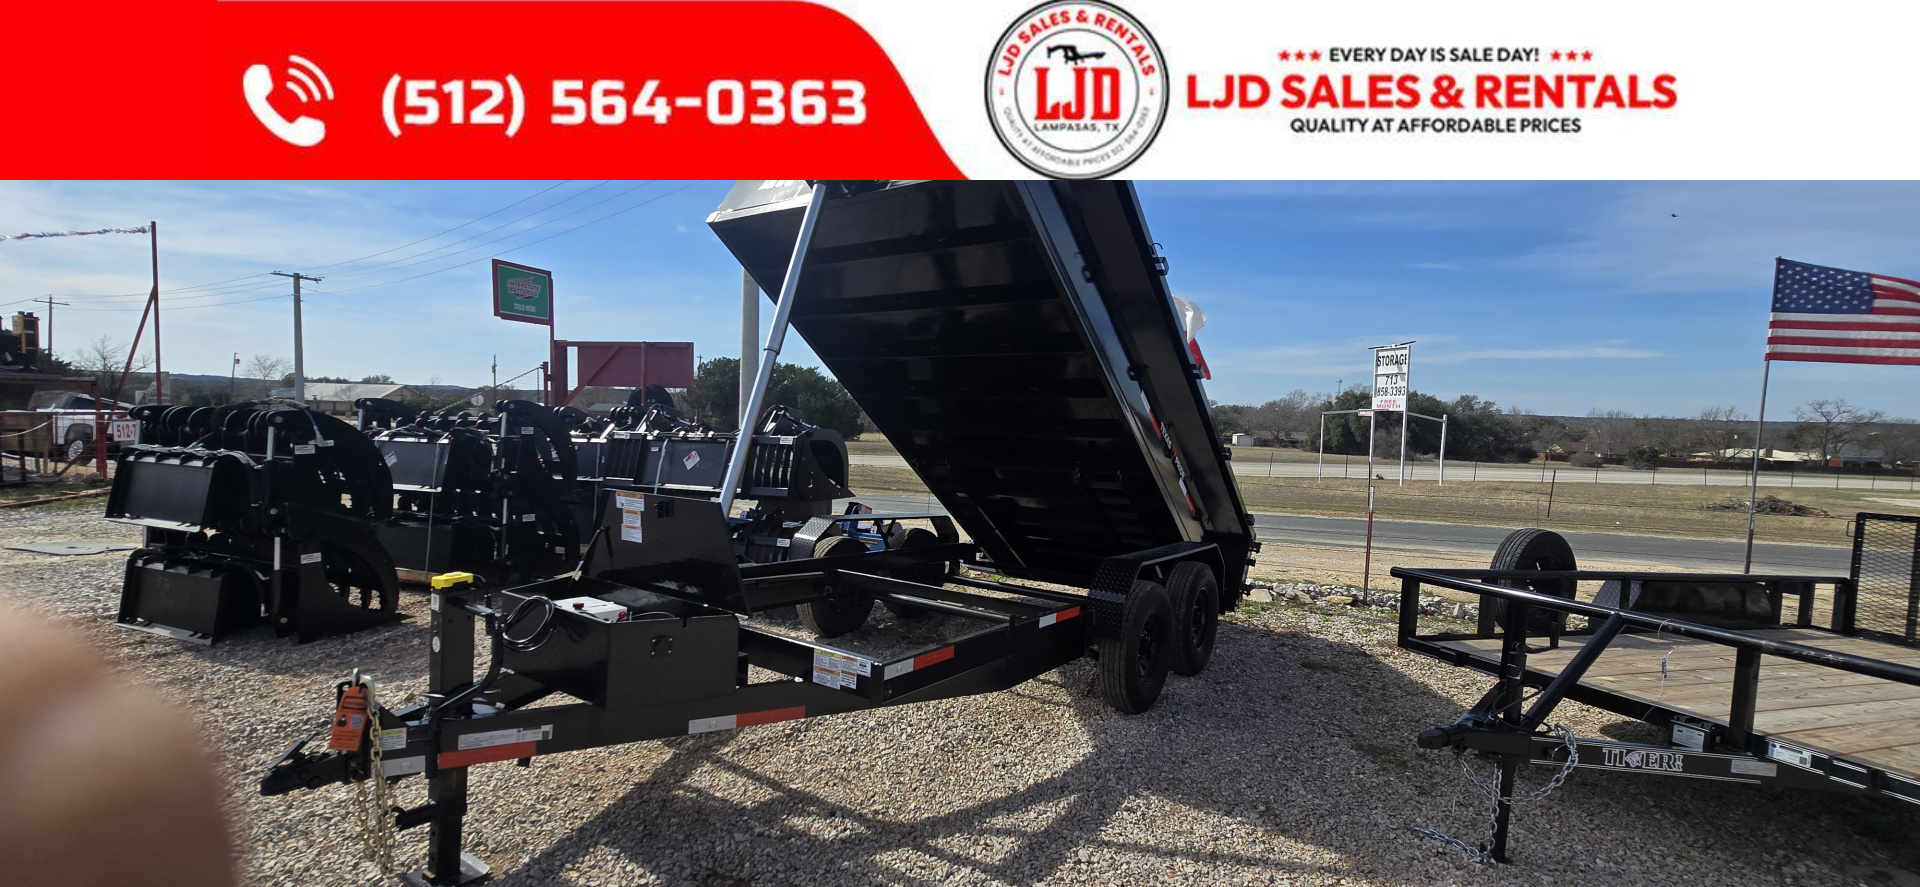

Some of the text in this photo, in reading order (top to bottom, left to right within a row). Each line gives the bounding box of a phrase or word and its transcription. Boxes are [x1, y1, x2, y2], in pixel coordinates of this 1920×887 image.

[508, 280, 540, 291] INTERSTATE
[1385, 374, 1398, 385] 713
[1377, 386, 1405, 396] 858-3393
